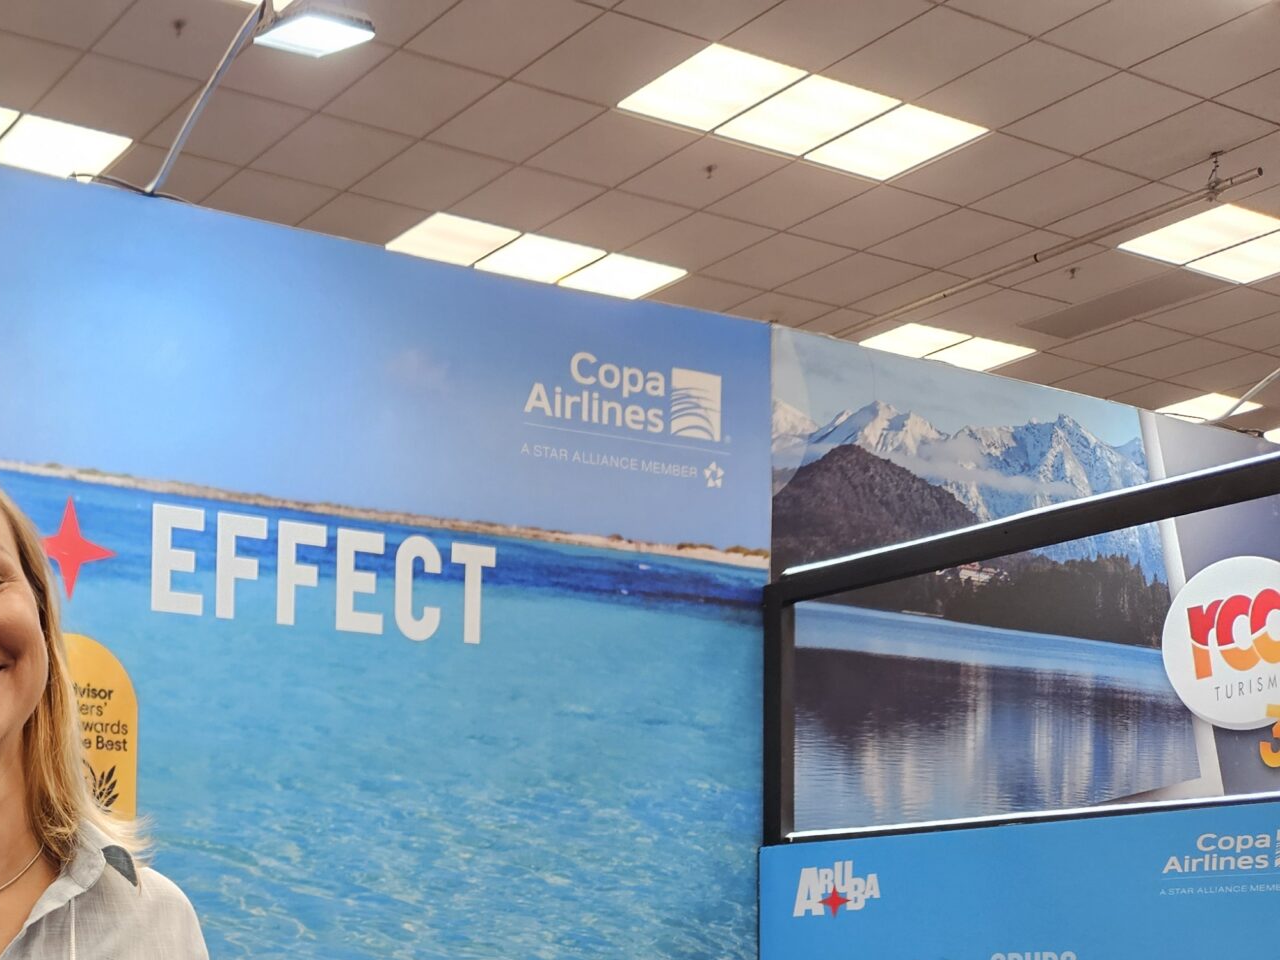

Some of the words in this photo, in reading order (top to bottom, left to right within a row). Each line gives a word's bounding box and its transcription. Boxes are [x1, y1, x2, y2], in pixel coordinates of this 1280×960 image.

[570, 351, 665, 398] Copa
[524, 382, 664, 434] Airlines
[521, 443, 531, 456] A
[533, 444, 568, 461] STAR
[572, 450, 638, 471] ALLIANCE
[641, 461, 698, 478] MEMBER
[150, 502, 497, 645] EFFECT
[96, 735, 128, 752] Best
[1196, 833, 1271, 853] Copa
[1162, 853, 1269, 874] Airlines
[793, 860, 881, 917] ARUBA
[1168, 887, 1194, 895] STAR
[1197, 885, 1248, 894] ALLIANCE
